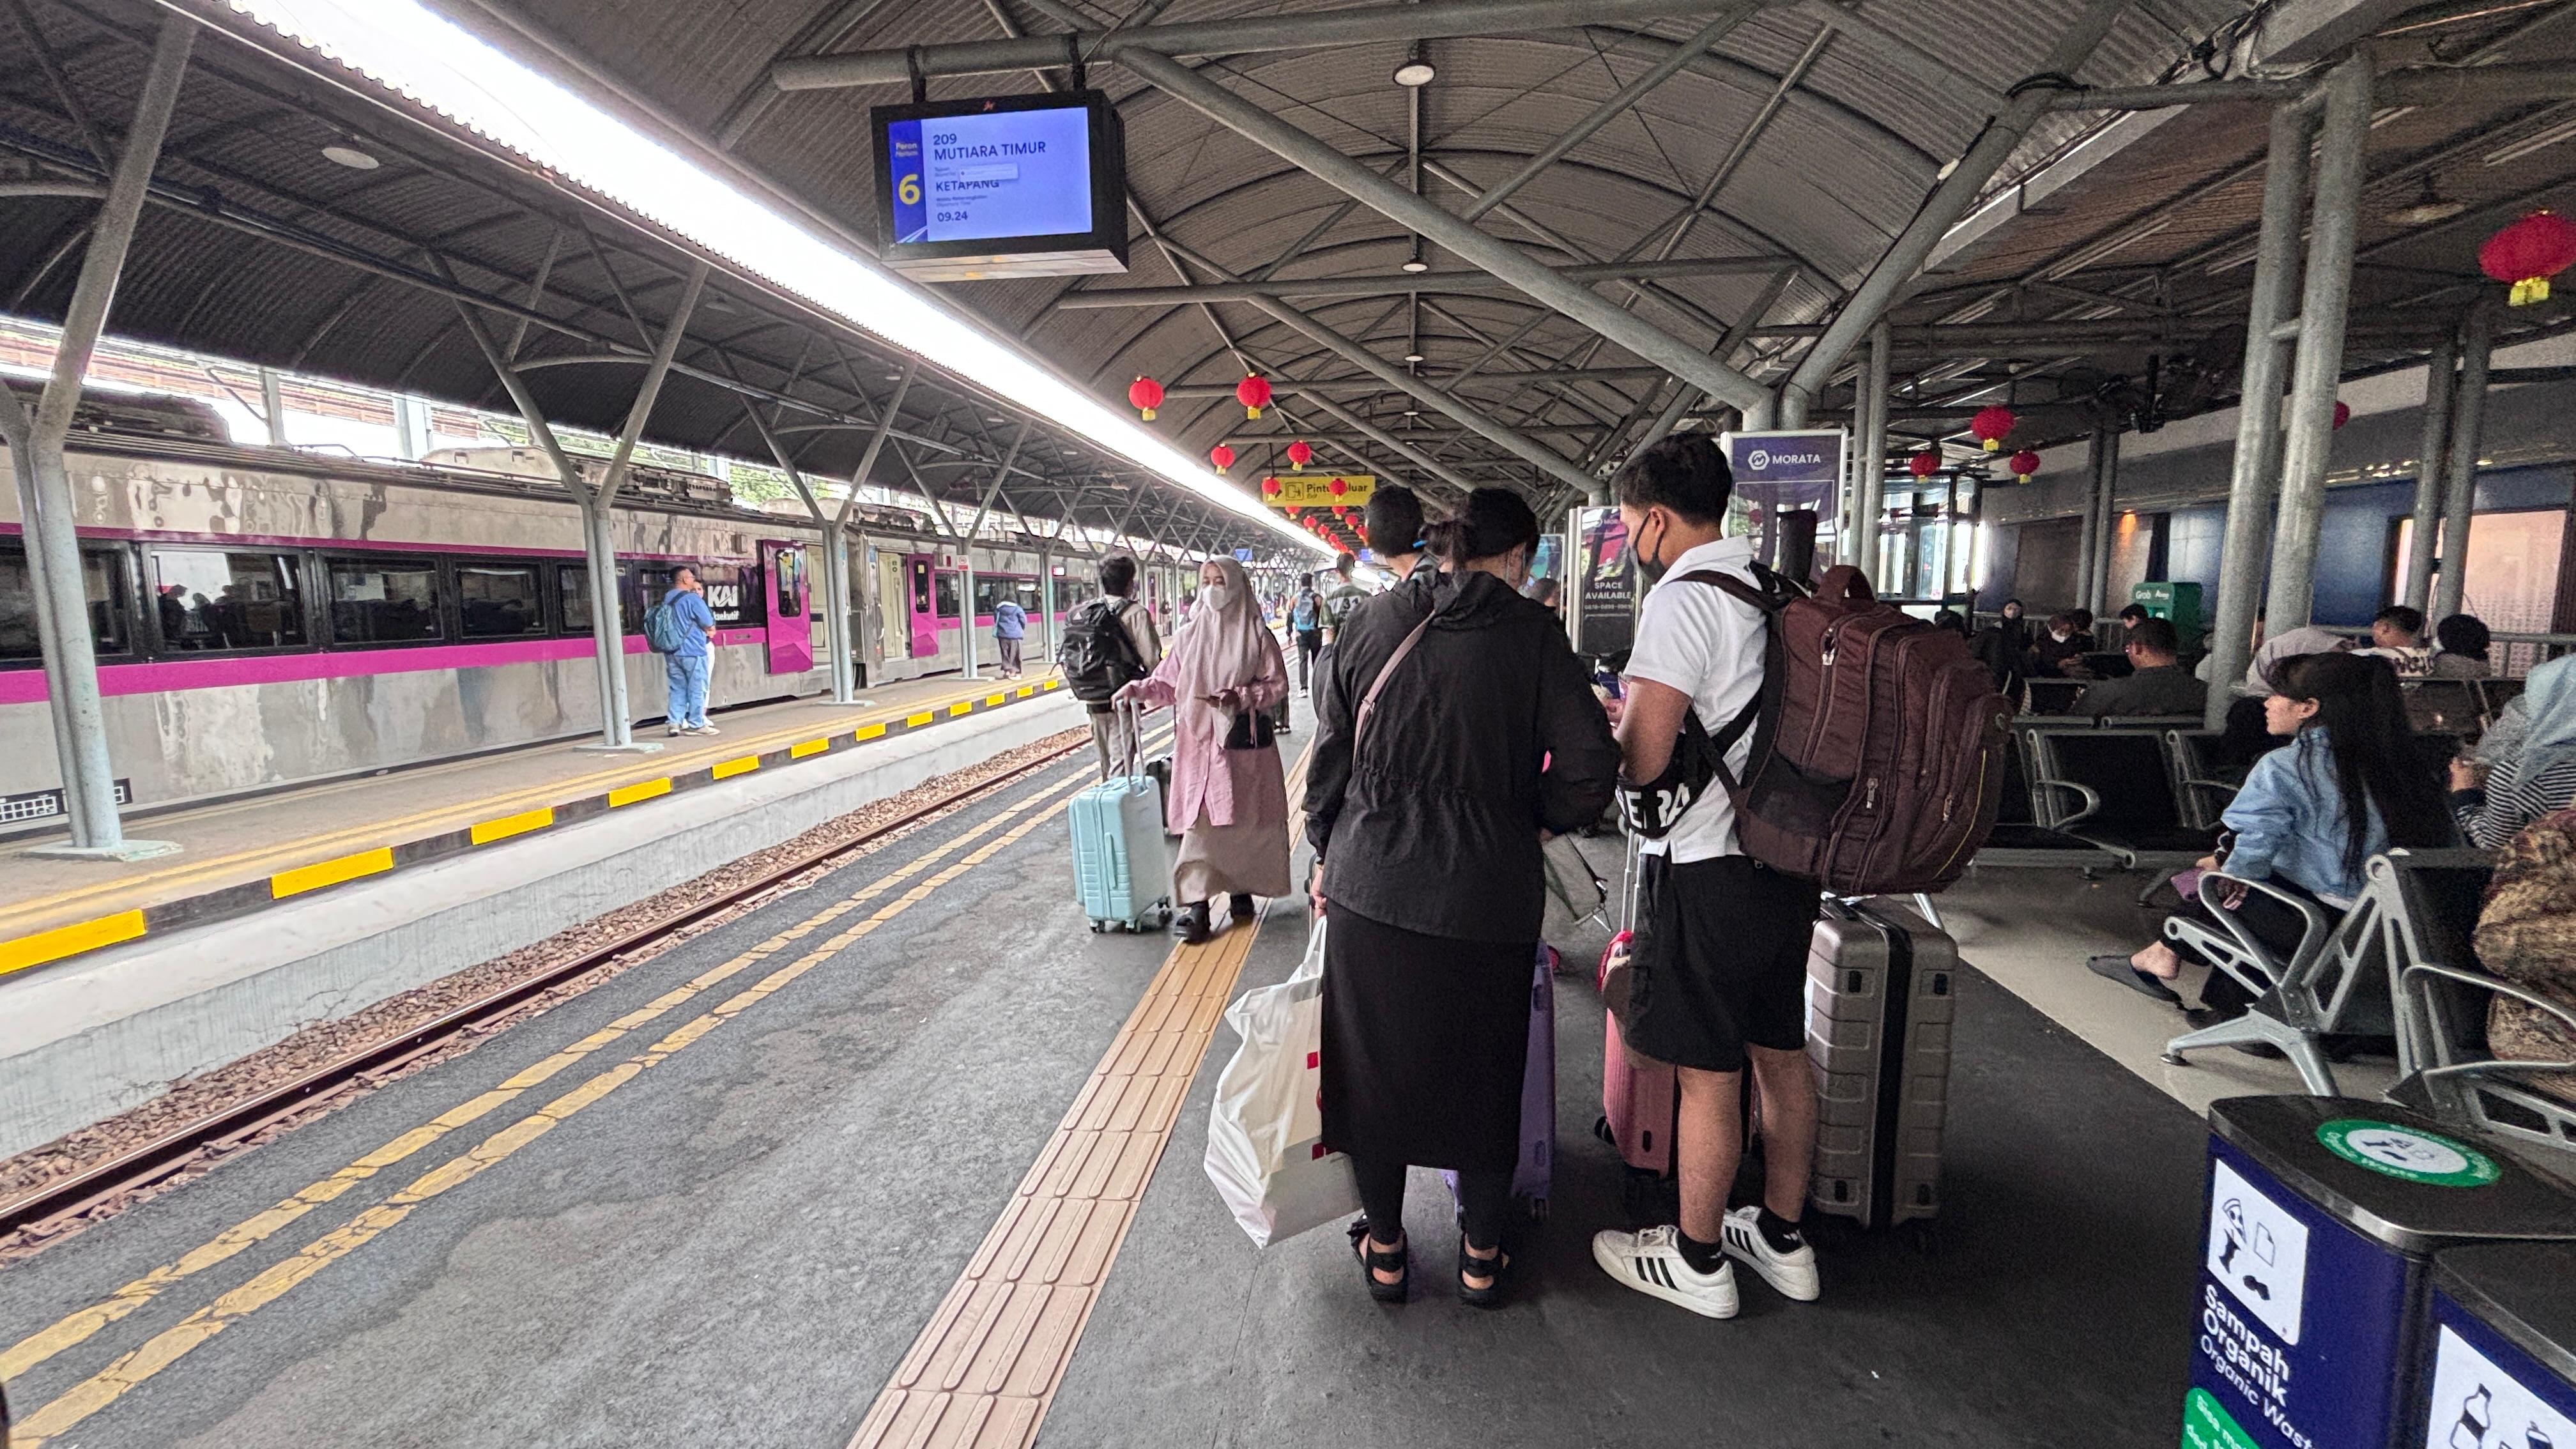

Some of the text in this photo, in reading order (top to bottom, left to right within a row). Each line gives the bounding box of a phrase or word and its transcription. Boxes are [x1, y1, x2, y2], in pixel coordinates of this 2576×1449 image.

[933, 133, 957, 146] 209
[934, 144, 999, 160] MUTIARA
[1001, 141, 1046, 156] TIMUR
[898, 173, 921, 205] 6
[935, 180, 1000, 192] KETAPANG
[937, 211, 969, 222] 09.24
[1772, 454, 1821, 464] MORATA
[707, 585, 739, 608] KAI
[1585, 591, 1632, 599] AVAILABLE
[712, 610, 739, 621] ksekutif
[2205, 1284, 2289, 1381] Sampah
[2204, 1308, 2288, 1407] Organik
[2200, 1334, 2260, 1406] Organic
[2263, 1397, 2315, 1449] Wast
